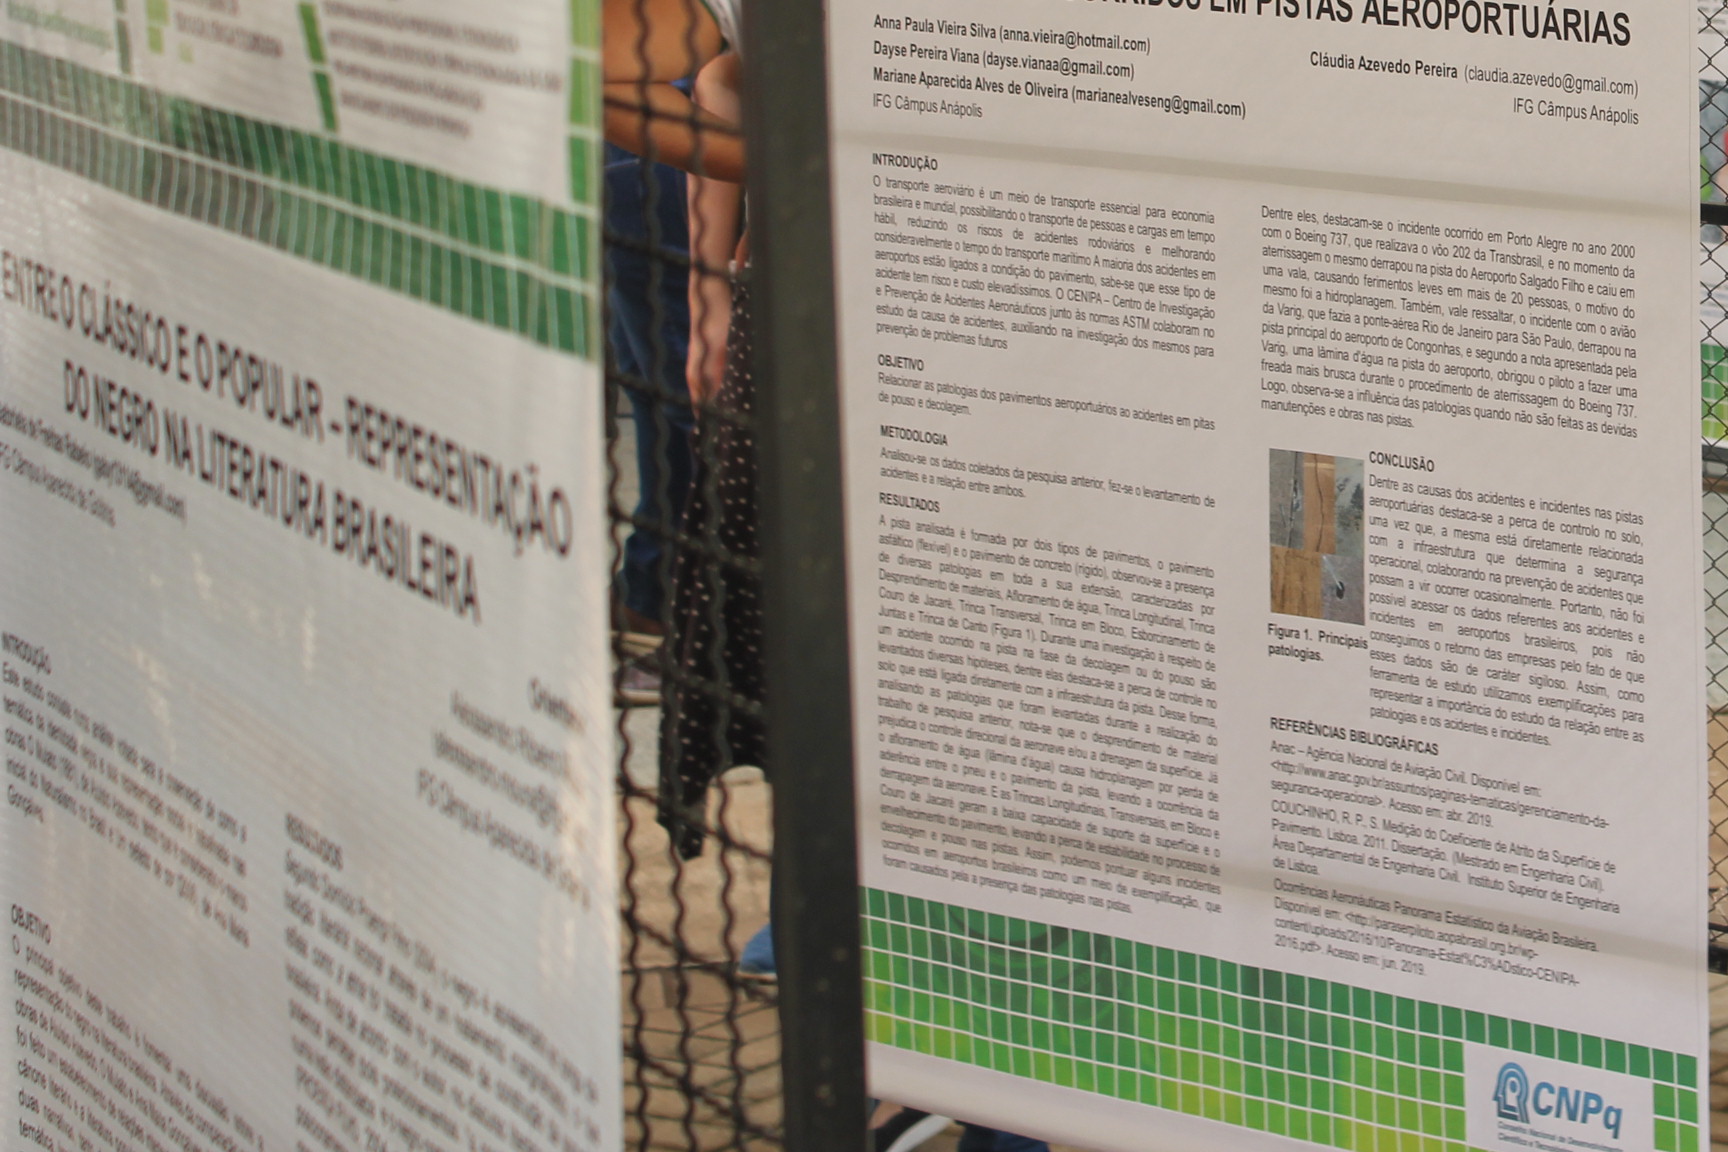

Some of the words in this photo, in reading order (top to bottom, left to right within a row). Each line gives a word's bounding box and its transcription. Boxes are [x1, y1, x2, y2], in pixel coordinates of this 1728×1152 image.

[873, 13, 901, 30] Anna
[904, 16, 934, 33] Paula
[936, 19, 967, 36] Vieira
[969, 22, 996, 39] Silva
[873, 39, 907, 59] Dayse
[909, 42, 947, 61] Pereira
[949, 47, 979, 64] Viana
[1310, 50, 1355, 69] Cláudia
[1357, 55, 1411, 74] Azevedo
[1415, 59, 1458, 79] Pereira
[873, 66, 917, 84] Mariane
[918, 70, 972, 90] Aparecida
[974, 76, 1004, 93] Alves
[1007, 79, 1021, 95] de
[1024, 80, 1068, 99] Oliveira
[872, 92, 892, 109] IFG
[894, 94, 938, 115] Câmpus
[939, 99, 983, 119] Anápolis
[1513, 97, 1534, 114] IFG
[1537, 99, 1587, 122] Câmpus
[1589, 104, 1639, 126] Anápolis
[872, 152, 938, 171] INTRODUÇÃO
[1261, 204, 1293, 220] Dentre
[1296, 209, 1319, 225] eles,
[1322, 212, 1383, 230] destacam-se
[1386, 221, 1393, 231] o
[1397, 219, 1441, 236] incidente
[1443, 226, 1484, 241] ocorrido
[1486, 232, 1502, 243] em
[1506, 230, 1533, 247] Porto
[1535, 234, 1568, 252] Alegre
[1571, 241, 1584, 253] no
[1587, 243, 1607, 255] ano
[1610, 242, 1635, 259] 2000
[877, 353, 924, 371] OBJETIVO
[2, 249, 58, 321] ENTRE
[60, 274, 75, 330] O
[79, 279, 172, 374] CLÁSSICO
[176, 323, 191, 383] E
[195, 331, 213, 392] O
[217, 339, 324, 444] POPULAR
[346, 394, 573, 558] REPRESENTAÇÃO
[880, 424, 948, 446] METODOLOGIA
[1368, 450, 1435, 472] CONCLUSÃO
[63, 358, 90, 421] DO
[94, 372, 160, 457] NEGRO
[163, 407, 194, 476] NA
[199, 423, 327, 547] LITERATURA
[332, 489, 482, 625] BRASILEIRA
[878, 491, 940, 513] RESULTADOS
[1267, 622, 1300, 640] Figura
[1303, 628, 1312, 641] 1.
[1318, 629, 1368, 649] Principais
[1268, 644, 1324, 662] patologias.
[1269, 716, 1346, 740] REFERÊNCIAS
[1349, 728, 1438, 756] BIBLIOGRÁFICAS
[11, 902, 52, 945] OBJETIVO
[1532, 1081, 1623, 1140] CNPq
